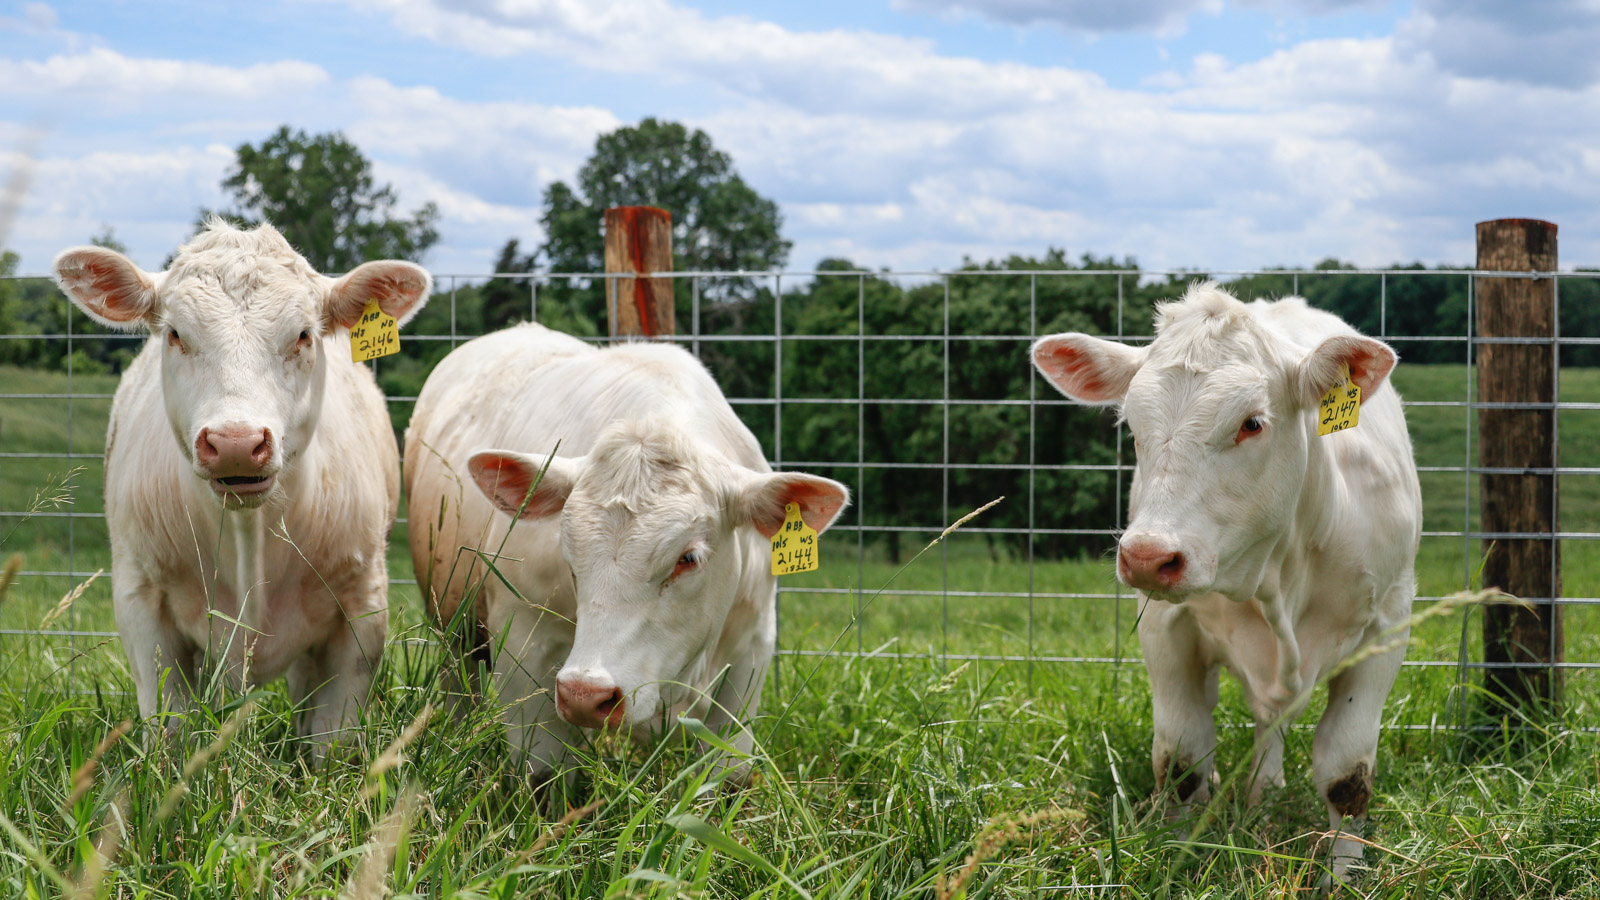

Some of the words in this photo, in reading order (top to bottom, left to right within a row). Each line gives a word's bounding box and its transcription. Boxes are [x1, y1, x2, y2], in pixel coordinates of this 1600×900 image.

[360, 331, 393, 351] 2146
[1322, 400, 1356, 425] 2147
[1331, 420, 1349, 433] 1067
[786, 521, 803, 532] ABB
[778, 546, 812, 565] 2144
